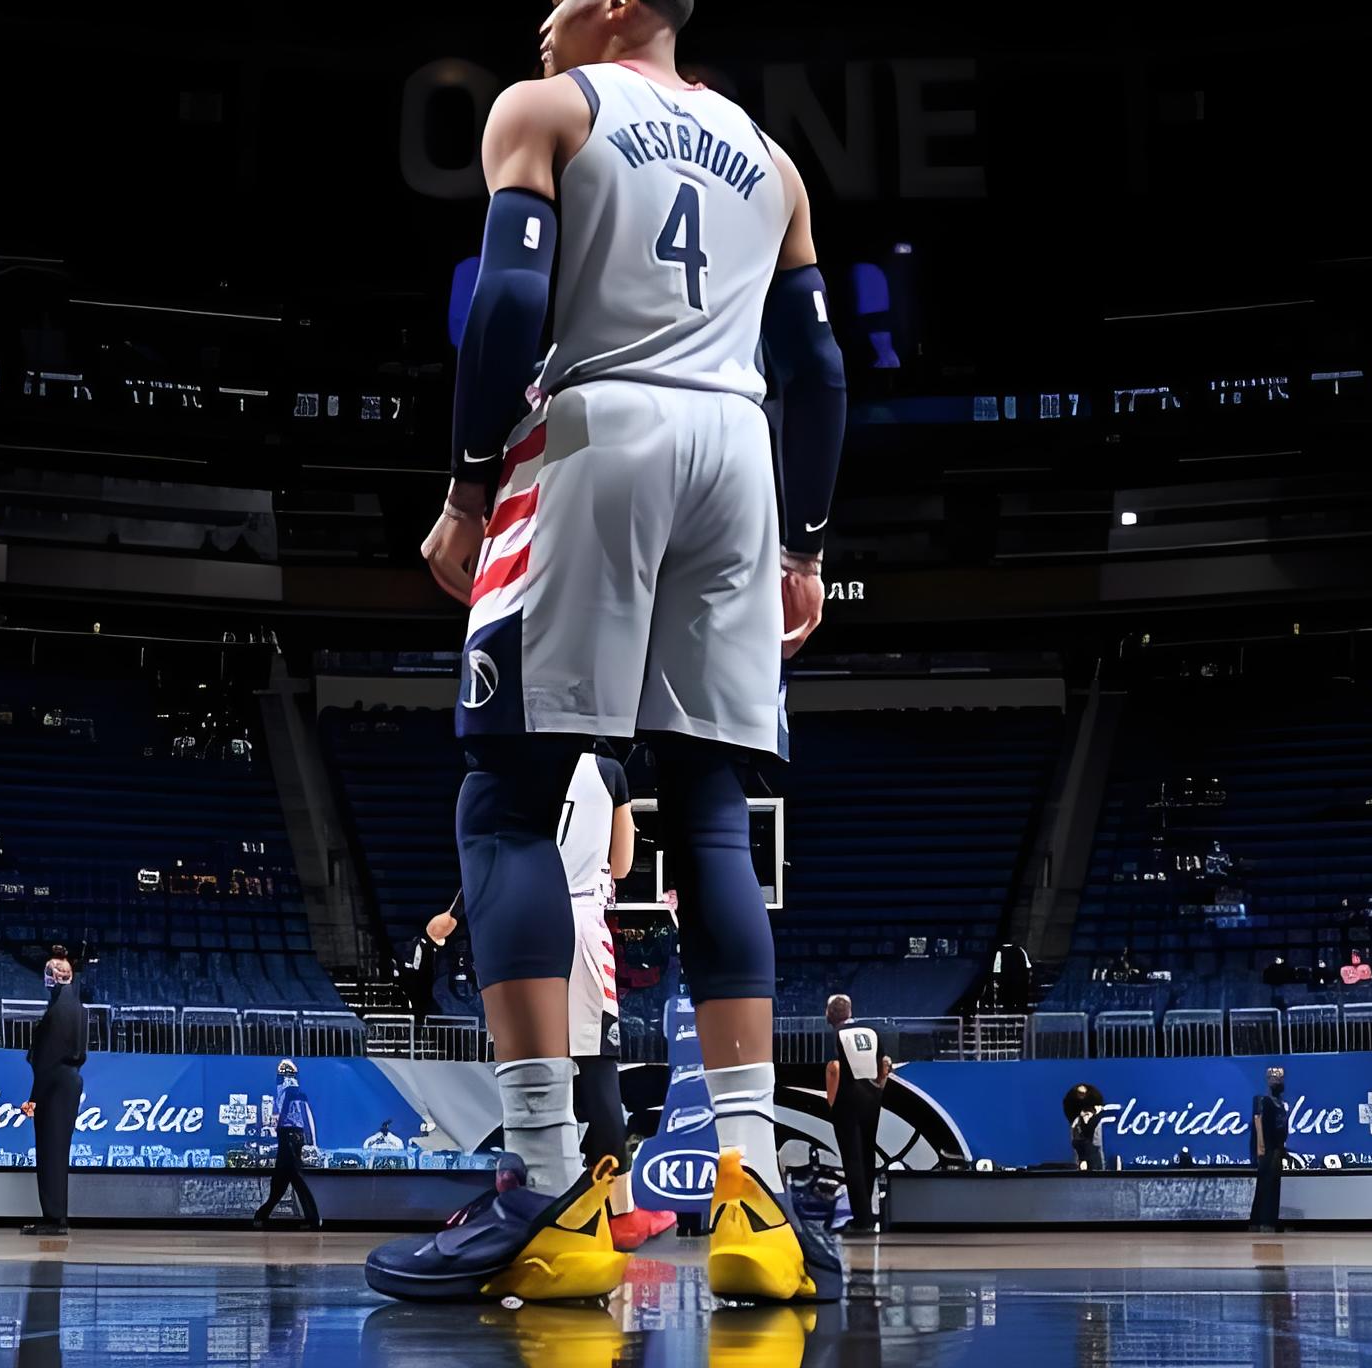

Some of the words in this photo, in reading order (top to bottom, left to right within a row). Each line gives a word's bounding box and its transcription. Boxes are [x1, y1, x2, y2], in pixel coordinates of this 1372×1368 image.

[607, 121, 766, 200] WESTBROOK
[655, 182, 708, 311] 4
[115, 1094, 204, 1133] Blue
[1284, 1095, 1344, 1134] lue
[659, 1160, 717, 1189] KIA
